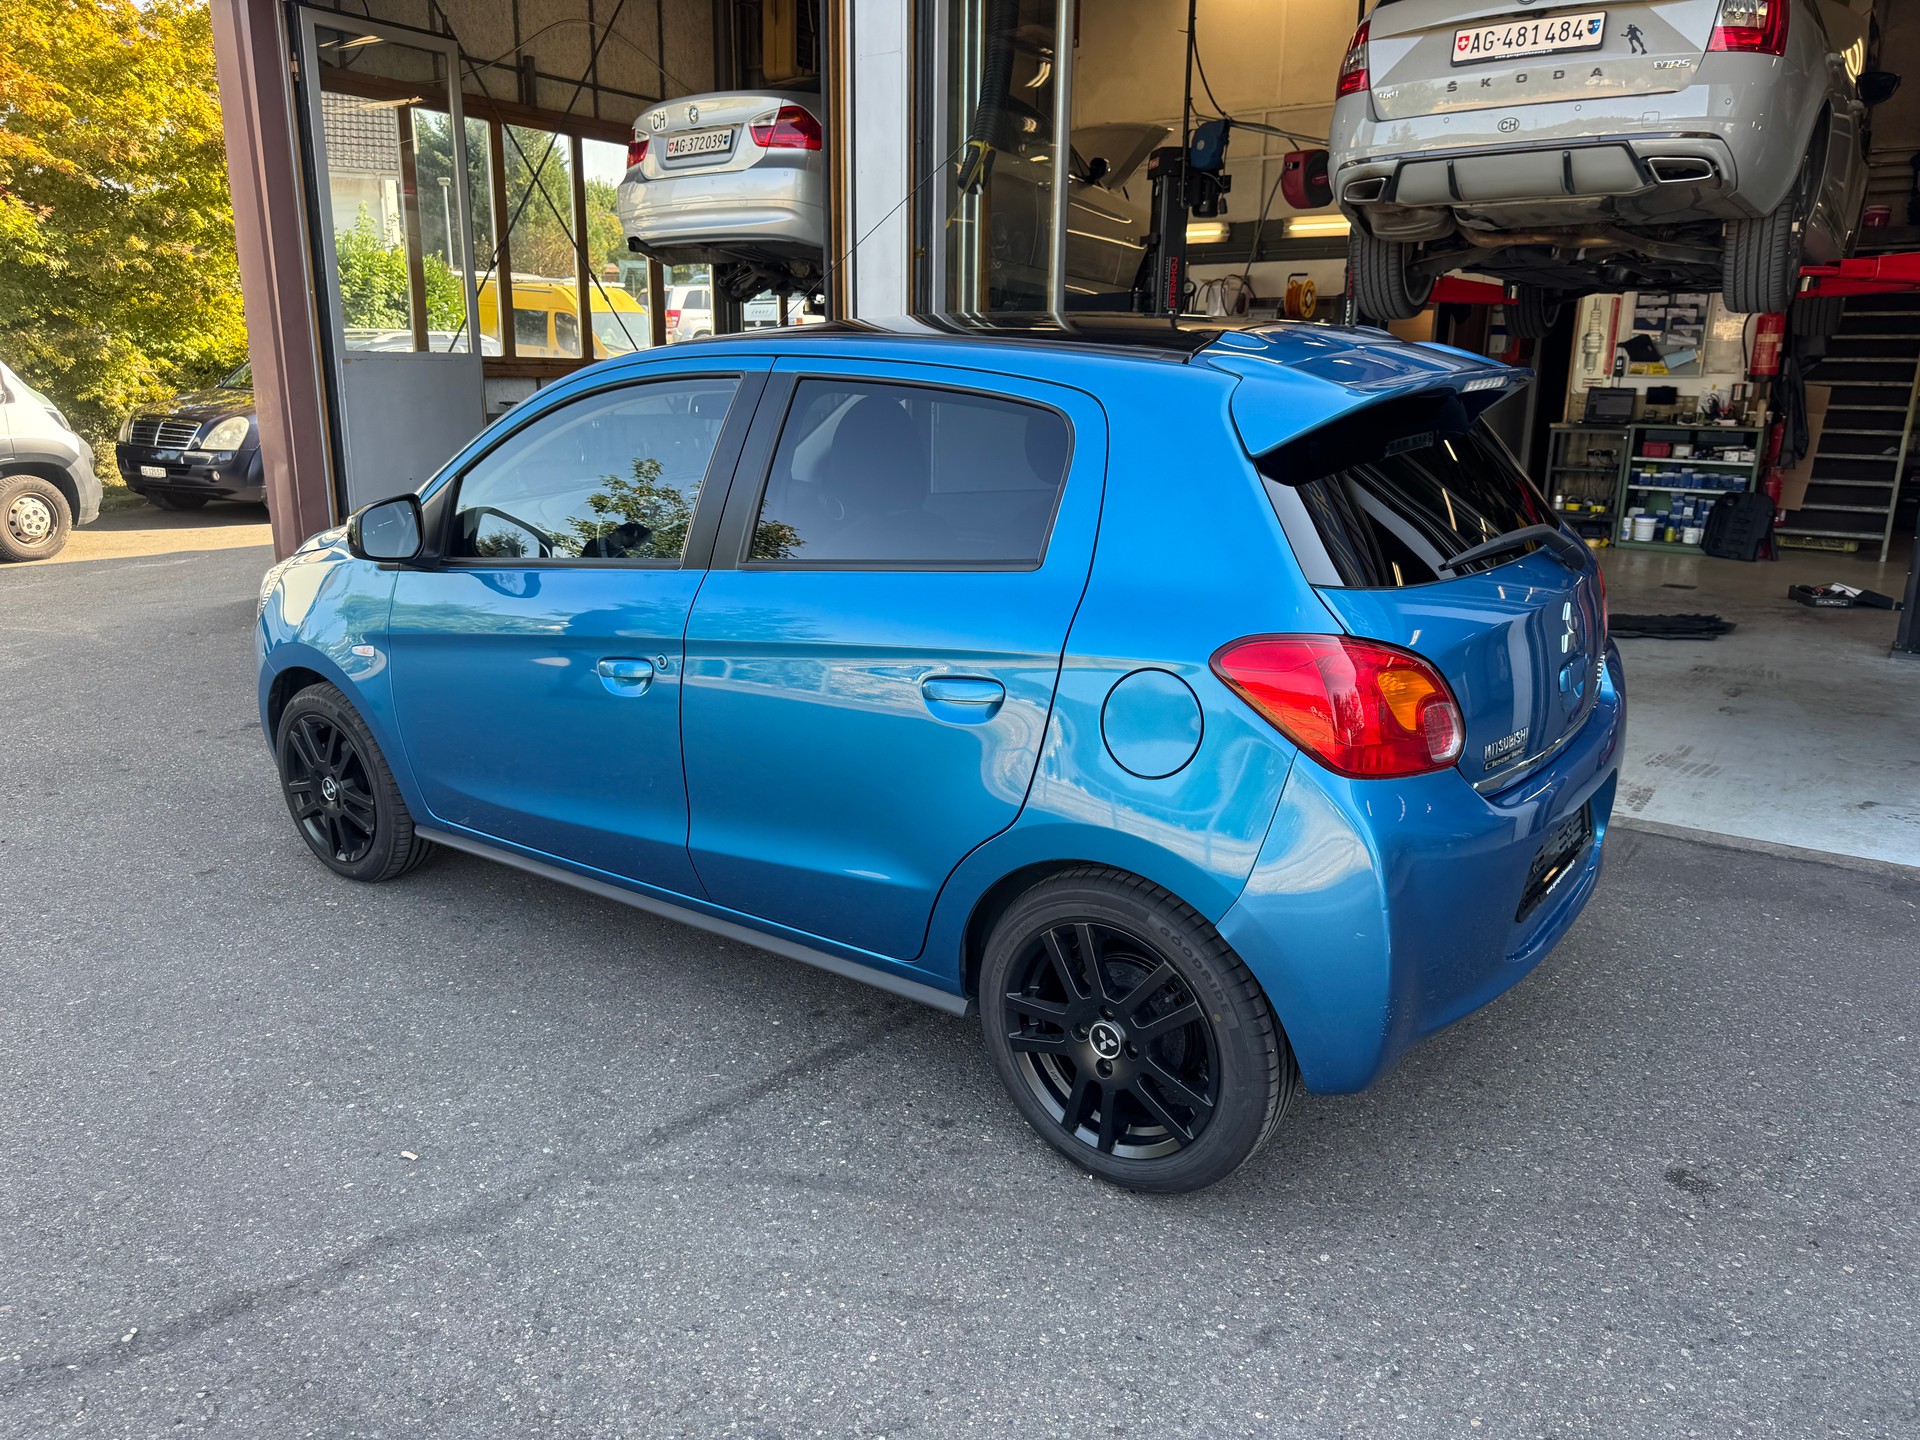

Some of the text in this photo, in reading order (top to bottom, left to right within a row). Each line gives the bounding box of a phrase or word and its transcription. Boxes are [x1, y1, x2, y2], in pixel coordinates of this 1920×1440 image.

[652, 111, 666, 130] CH
[1500, 120, 1517, 131] CH
[1160, 926, 1230, 1014] GOODRIDE
